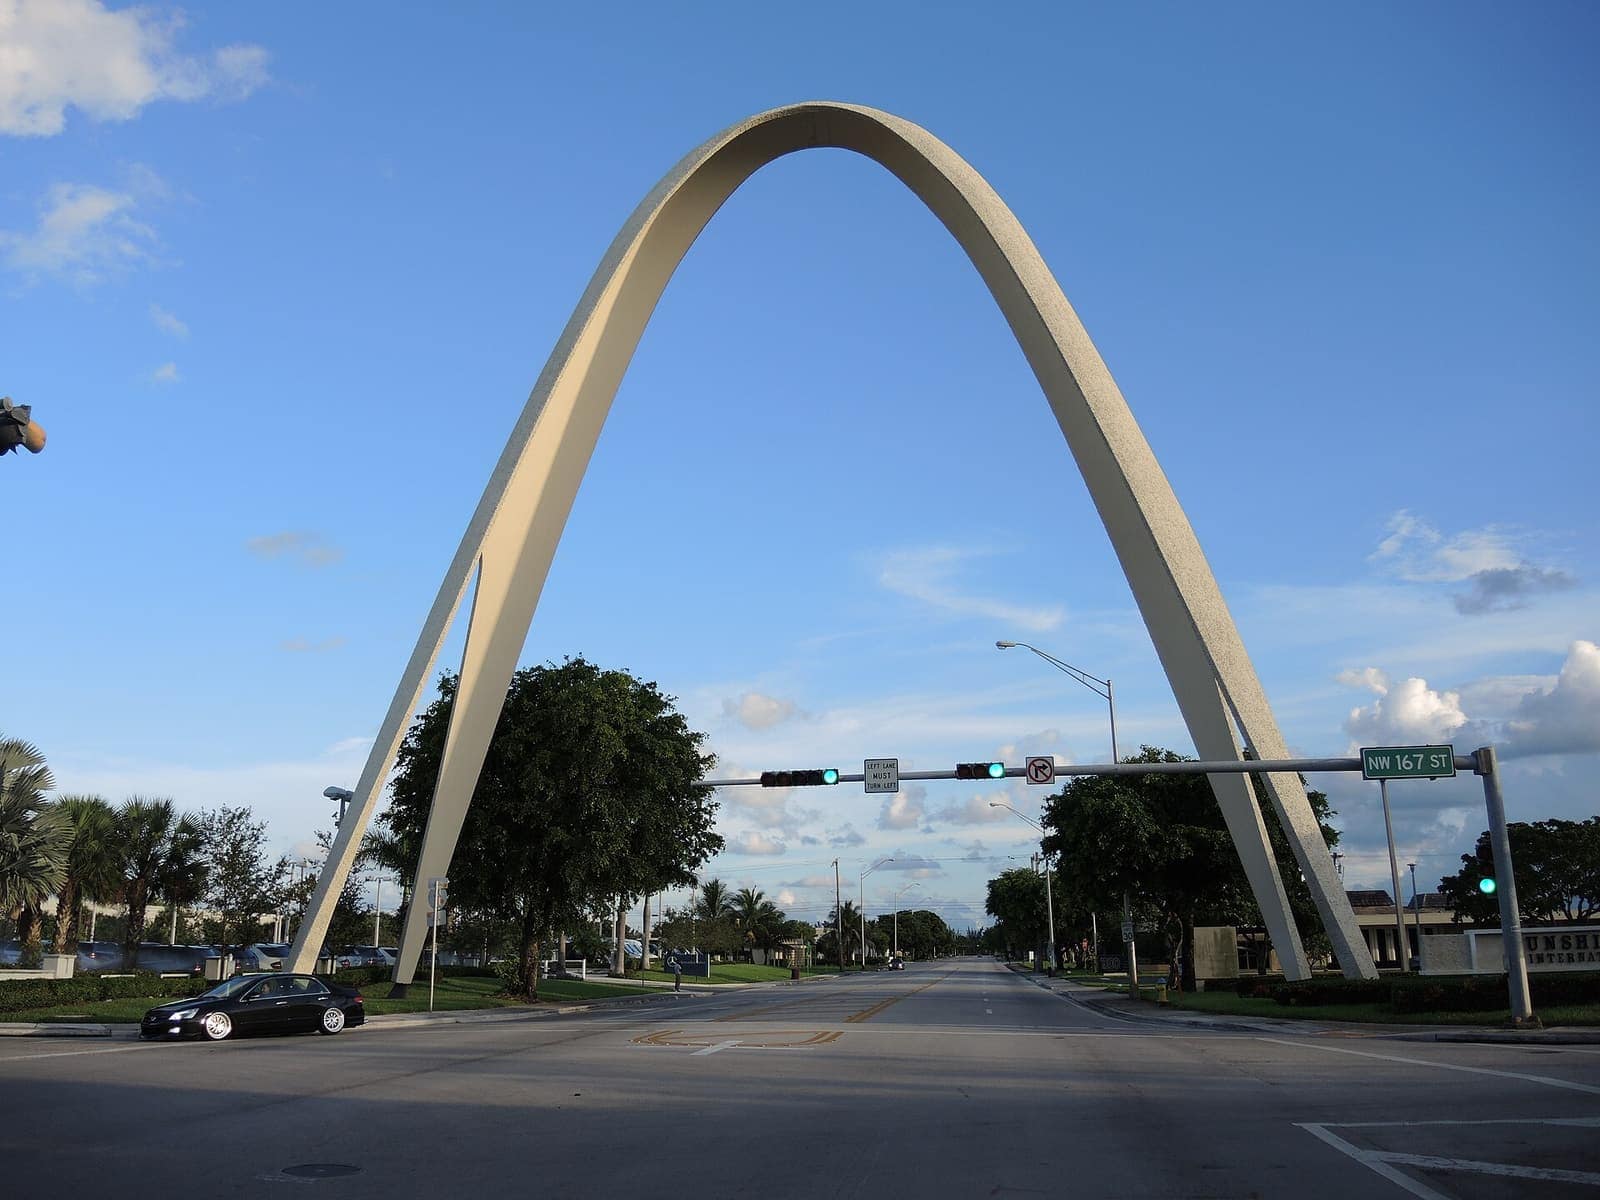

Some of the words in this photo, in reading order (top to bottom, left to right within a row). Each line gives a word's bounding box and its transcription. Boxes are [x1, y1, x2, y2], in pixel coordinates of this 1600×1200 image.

[1368, 756, 1390, 770] NW
[1395, 754, 1424, 770] 167
[1430, 754, 1447, 768] ST
[1124, 932, 1133, 940] 30
[1526, 935, 1600, 950] UNSHI
